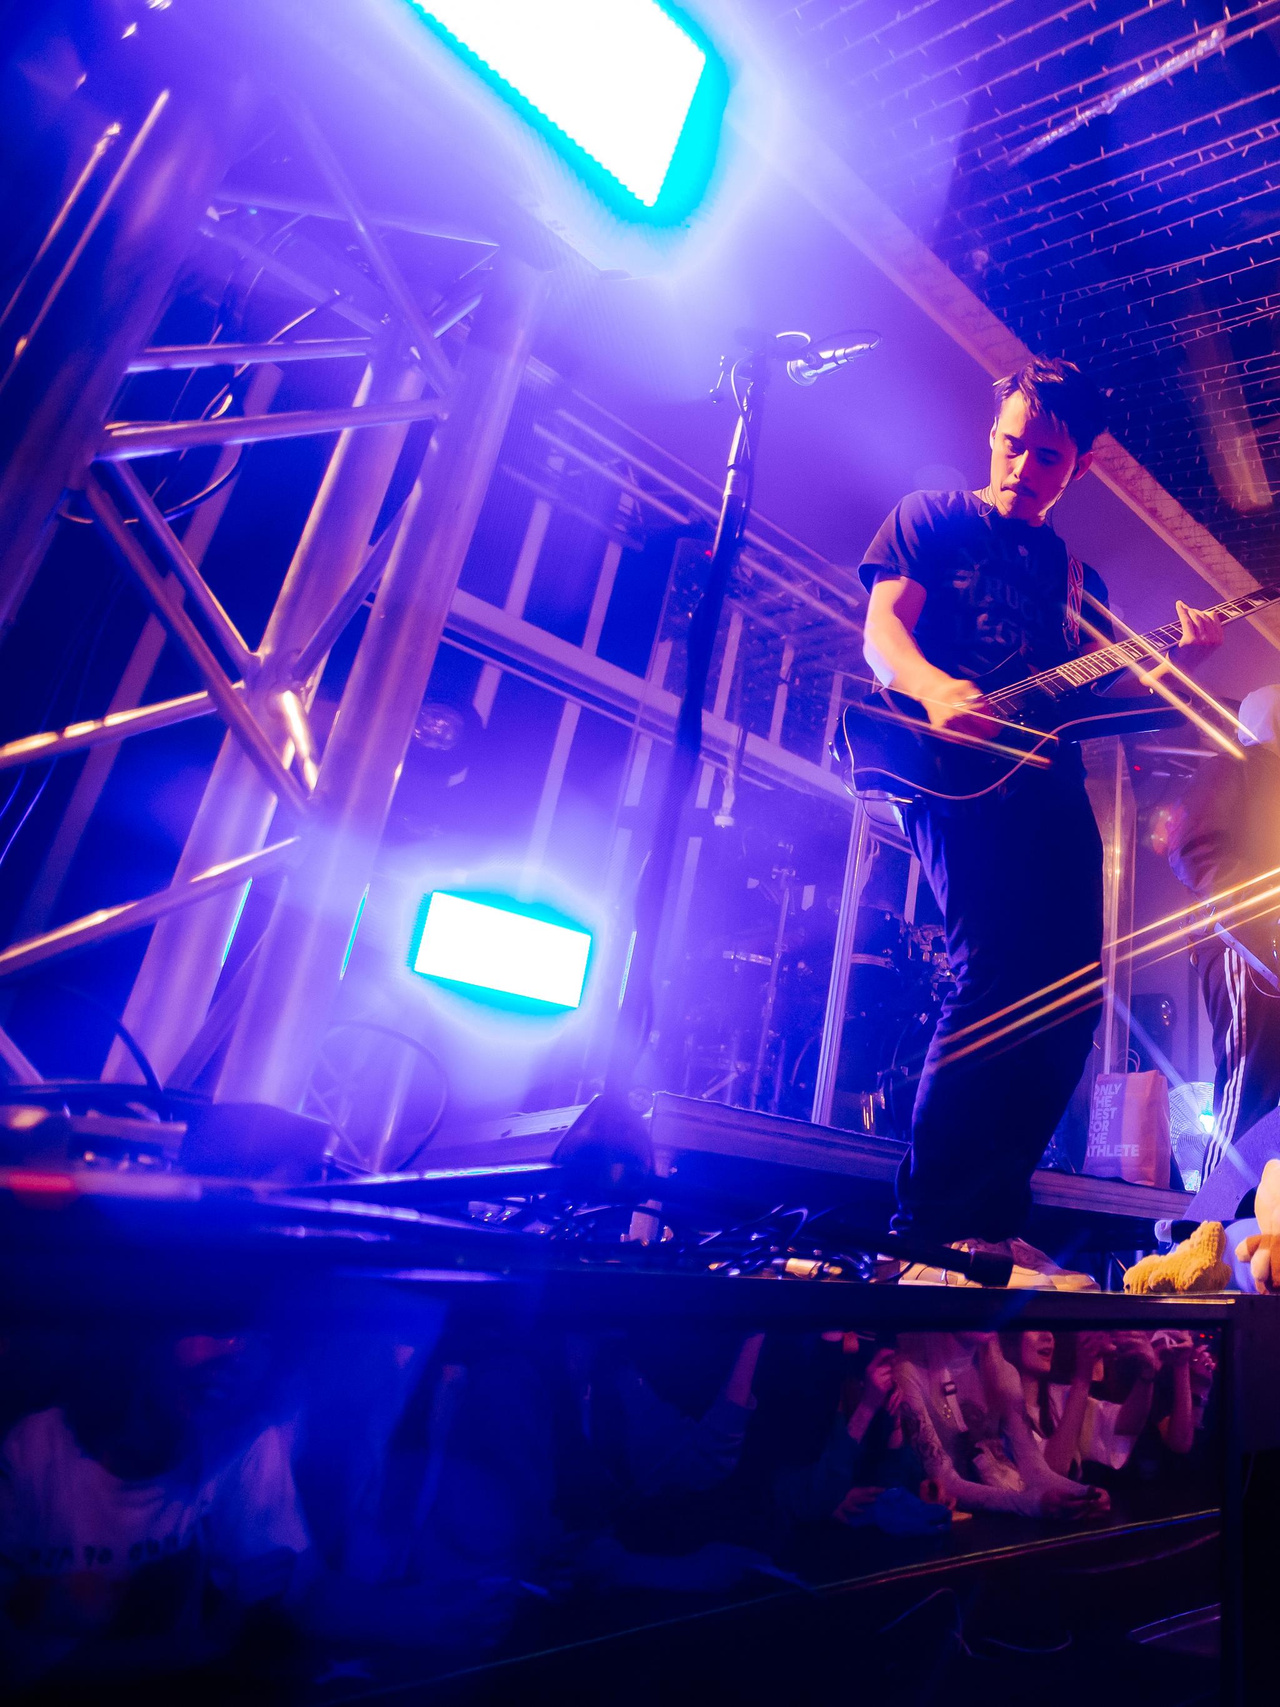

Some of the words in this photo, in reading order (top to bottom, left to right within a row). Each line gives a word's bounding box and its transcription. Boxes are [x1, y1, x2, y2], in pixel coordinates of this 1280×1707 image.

[1095, 1095, 1112, 1108] HE
[1090, 1120, 1110, 1132] OR
[1089, 1132, 1108, 1145] HE
